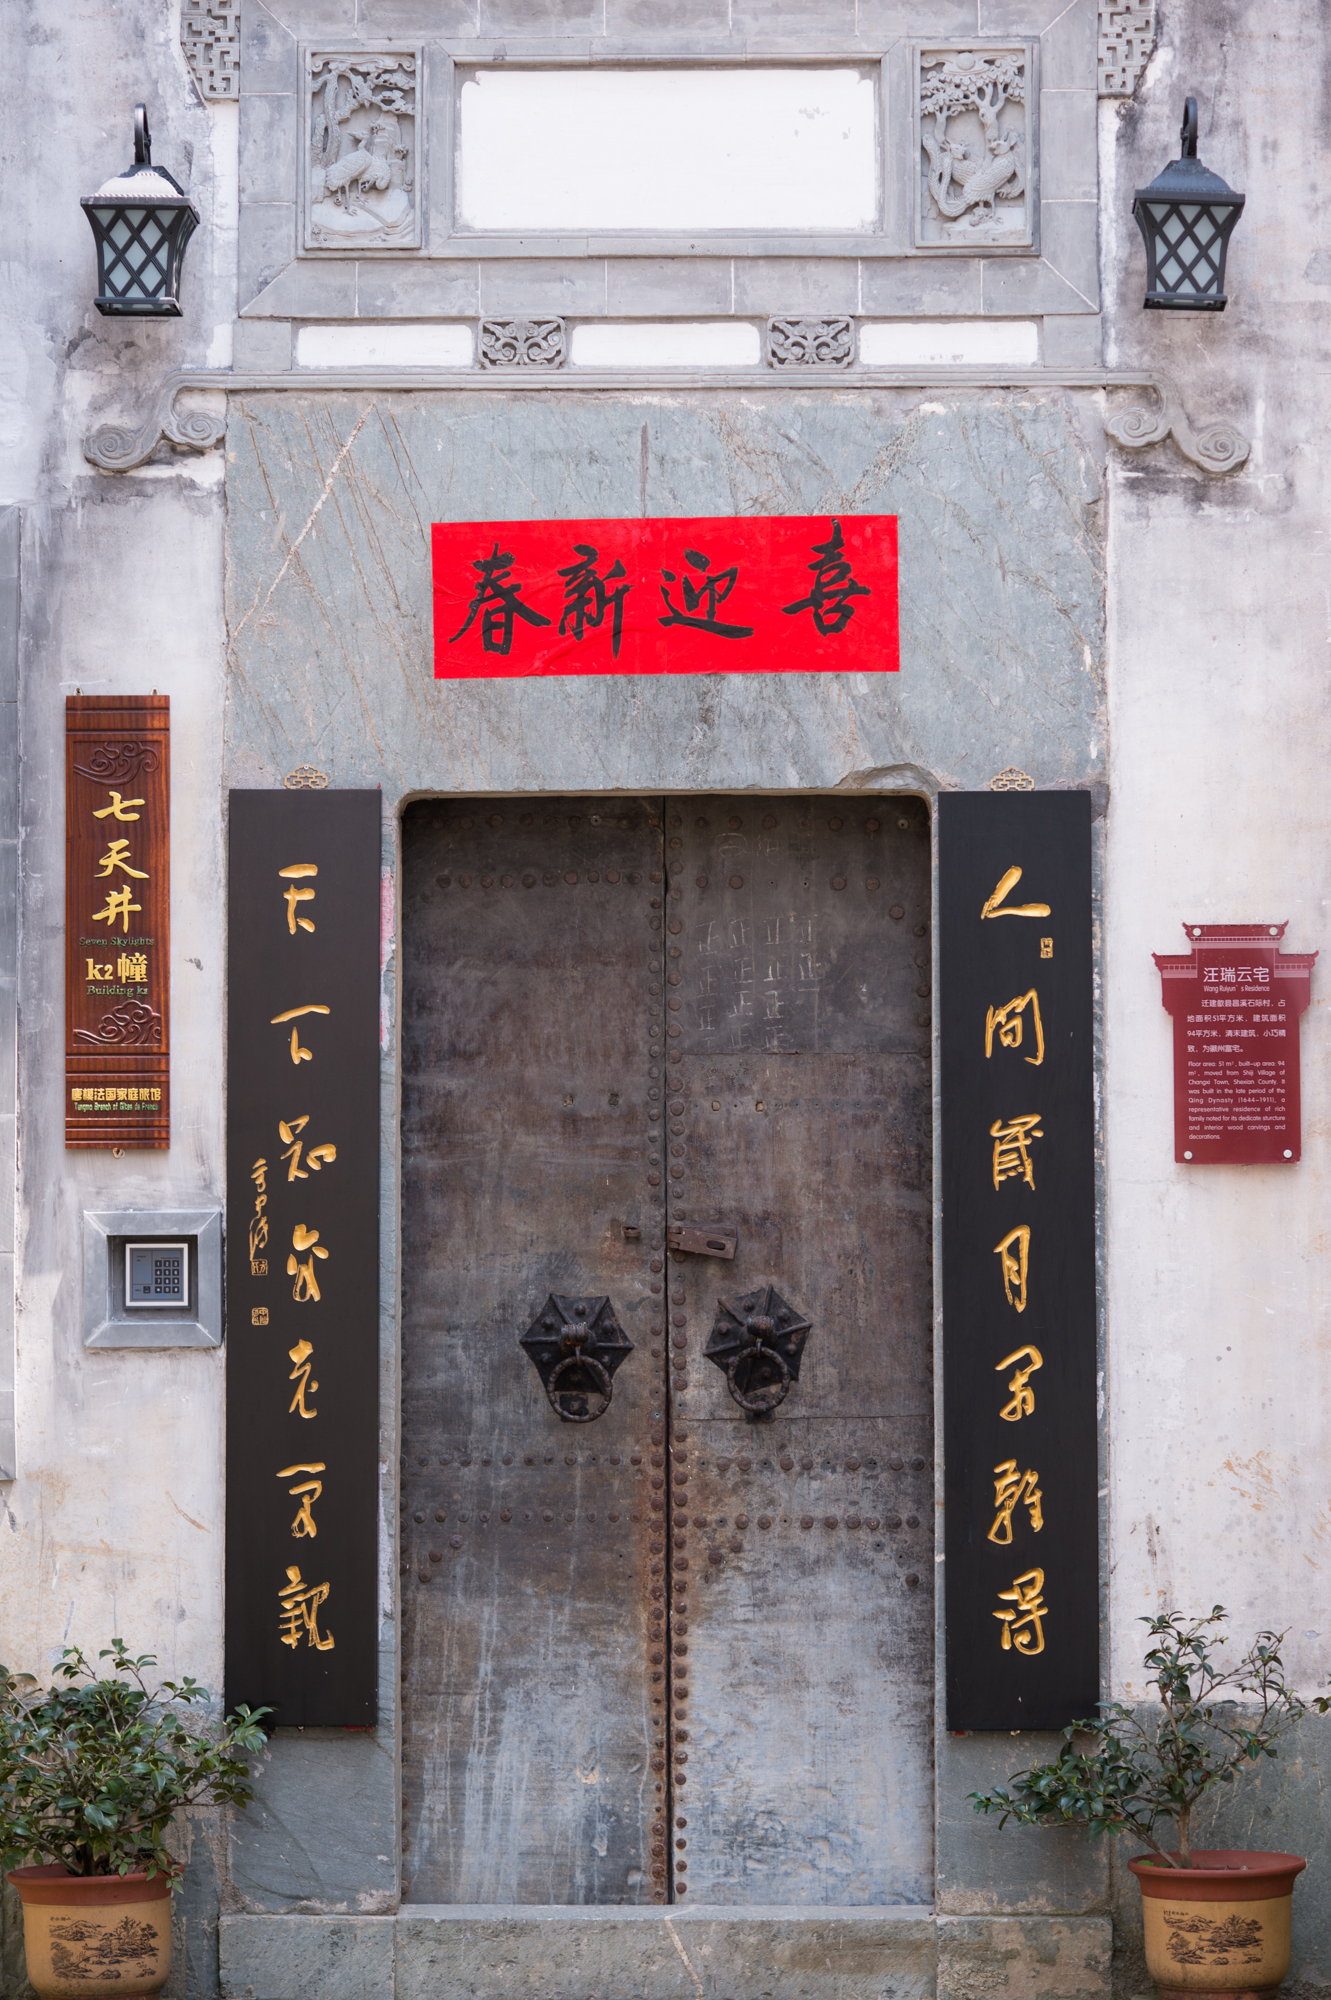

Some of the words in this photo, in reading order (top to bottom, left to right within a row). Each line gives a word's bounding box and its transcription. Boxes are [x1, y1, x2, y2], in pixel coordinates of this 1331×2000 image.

[448, 518, 872, 659] 喜迎新春
[92, 791, 150, 934] 七天井
[79, 937, 107, 946] Seven
[110, 937, 154, 946] Skylights
[1204, 967, 1269, 982] 汪瑞云宅
[87, 985, 134, 997] Building
[1204, 985, 1218, 993] Wang
[71, 1088, 161, 1101] 唐模法国家庭旅馆
[113, 1102, 118, 1110] of
